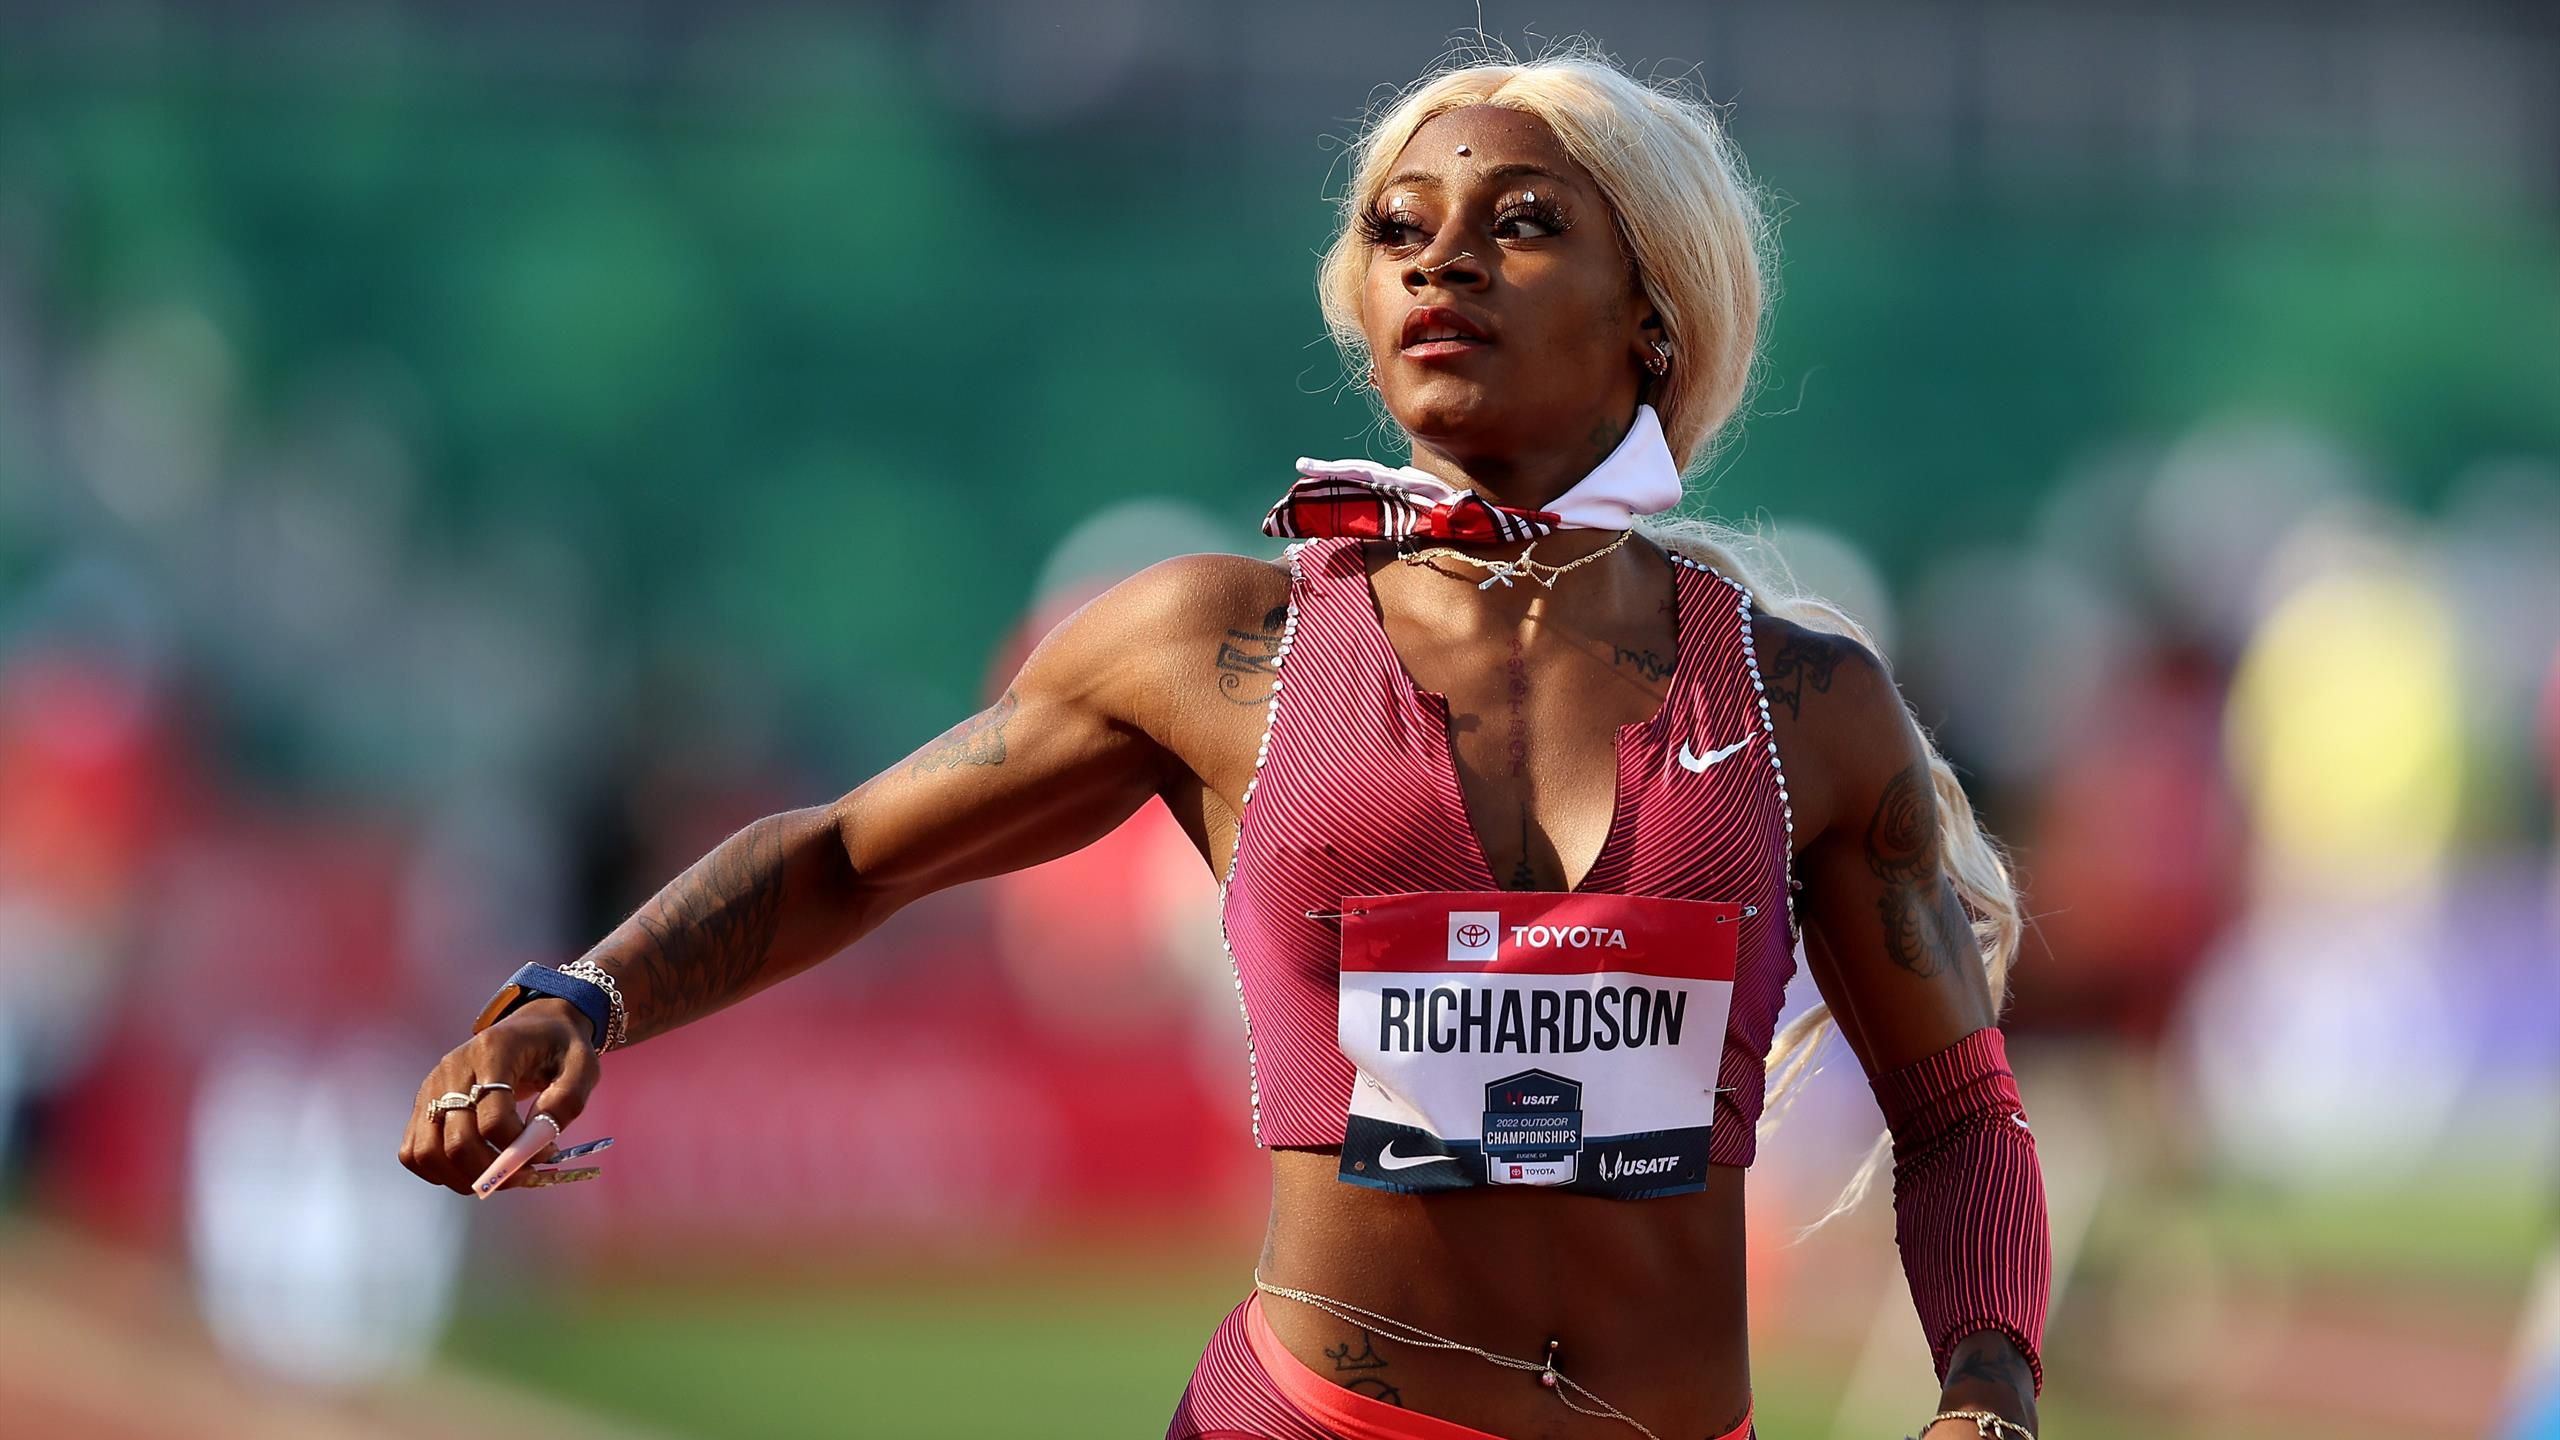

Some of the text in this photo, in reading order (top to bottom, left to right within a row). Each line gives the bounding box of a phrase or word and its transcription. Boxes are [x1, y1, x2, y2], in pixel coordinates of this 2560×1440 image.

[1510, 925, 1627, 950] TOYOTA
[1379, 986, 1688, 1055] RICHARDSON
[1522, 1095, 1560, 1105] USATF
[1496, 1117, 1569, 1128] 2022 OUTDOOR
[1487, 1130, 1577, 1145] CHAMPIONSHIPS
[1622, 1156, 1680, 1177] USATF
